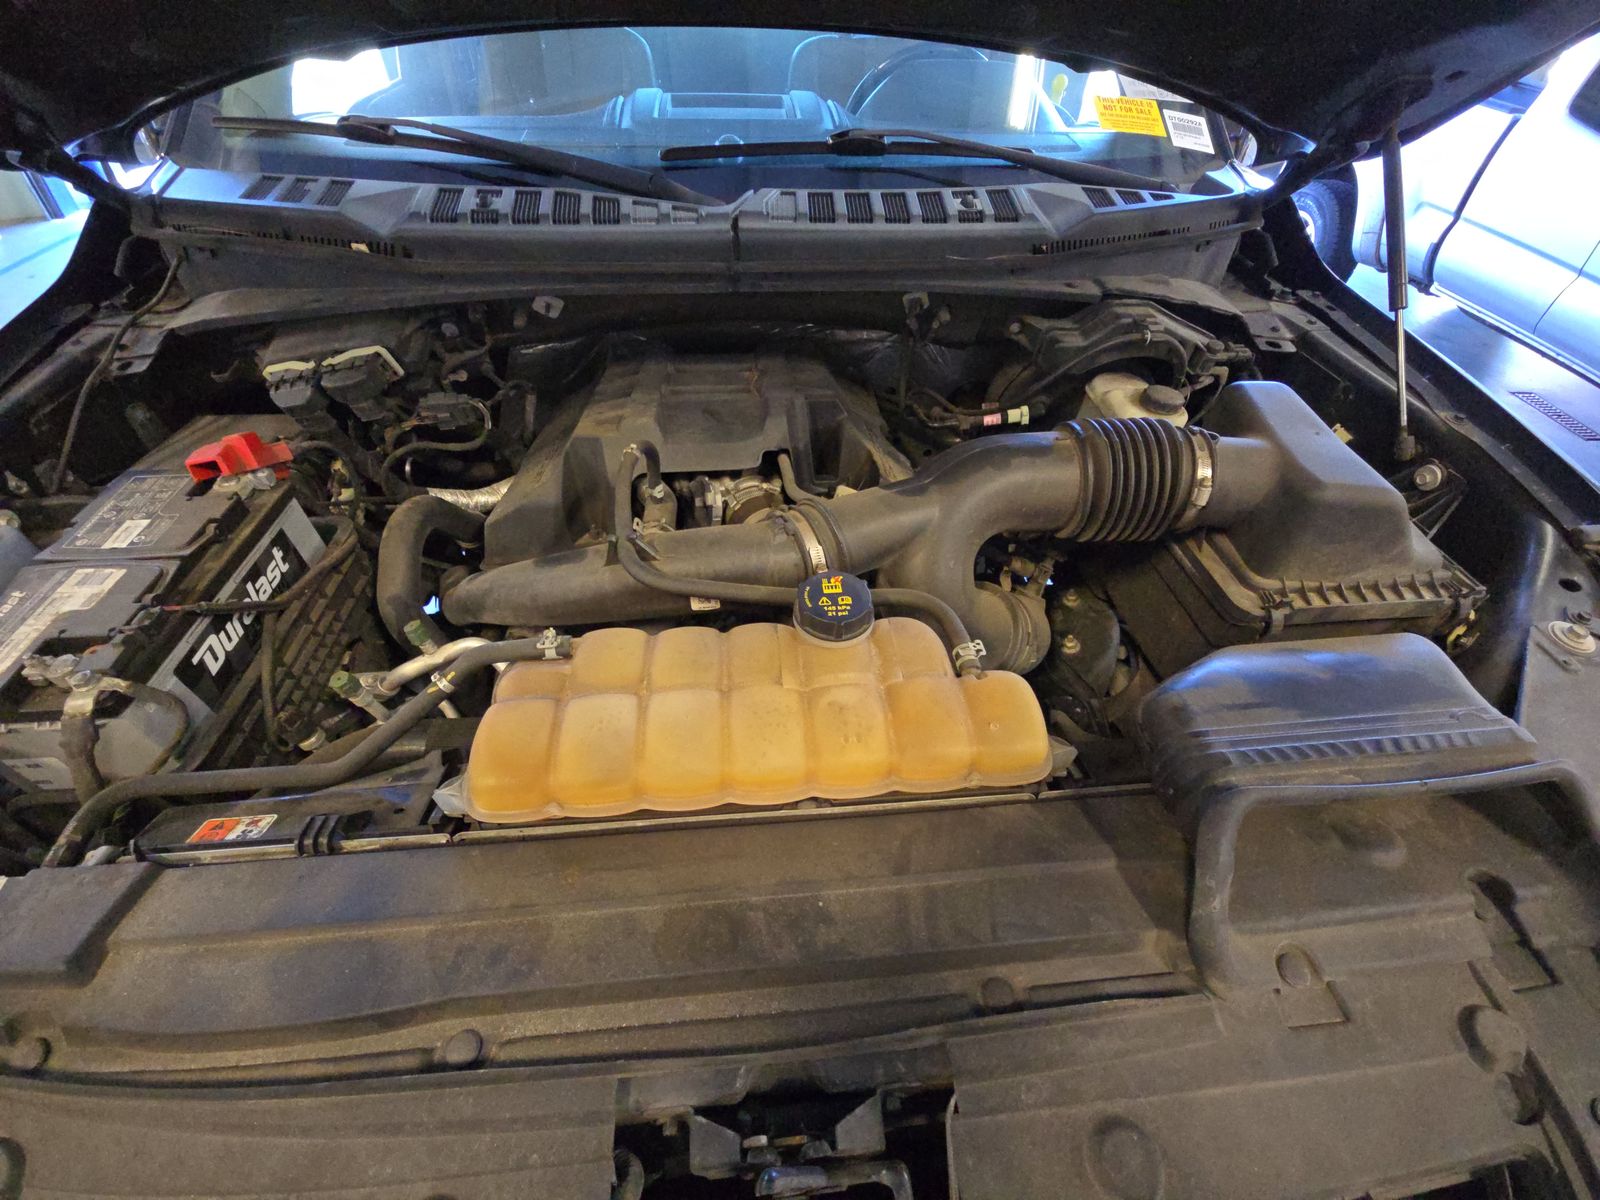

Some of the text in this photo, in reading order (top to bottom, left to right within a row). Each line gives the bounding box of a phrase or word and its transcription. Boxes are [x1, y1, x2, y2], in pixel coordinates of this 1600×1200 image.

[1096, 95, 1115, 104] THIS
[1116, 97, 1145, 107] VEHICLE
[1119, 105, 1134, 113] FOR
[1136, 108, 1152, 116] SALE
